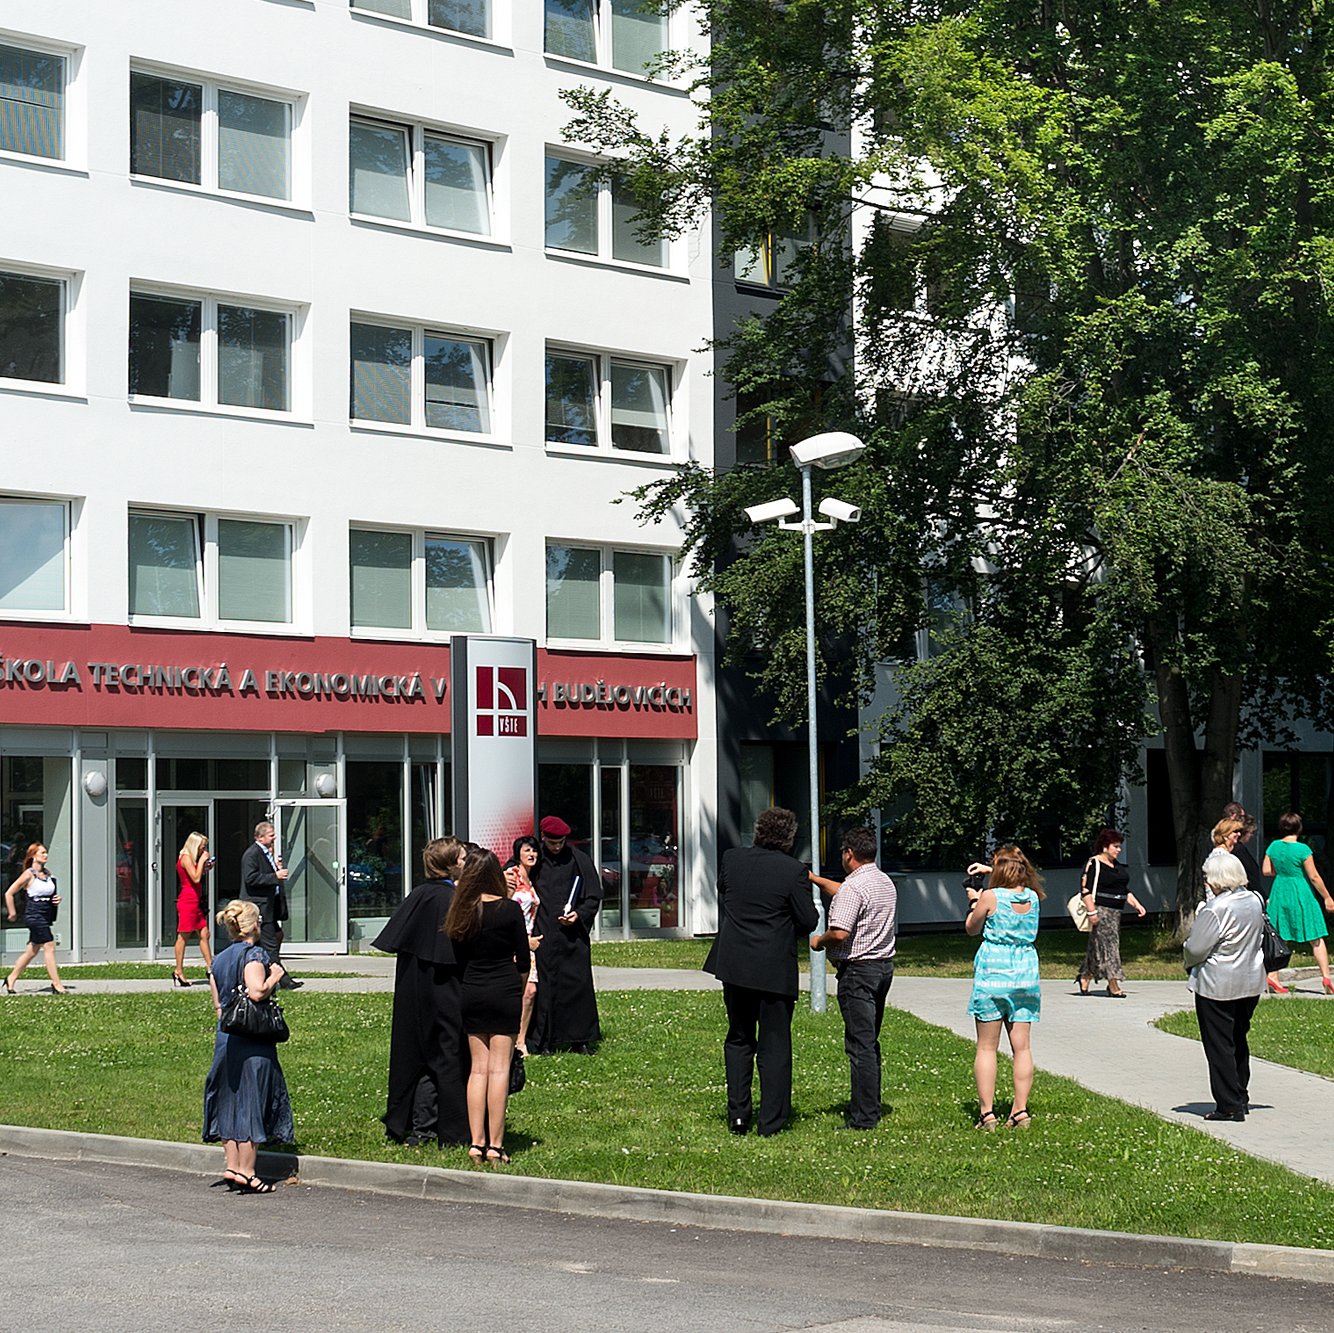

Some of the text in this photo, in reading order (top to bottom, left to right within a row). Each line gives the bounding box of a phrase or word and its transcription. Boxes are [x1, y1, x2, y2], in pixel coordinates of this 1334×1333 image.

[87, 662, 234, 690] TECHNICKÁ
[238, 668, 259, 691] A
[264, 670, 426, 698] EKONOMICKÁ
[431, 677, 446, 698] V
[552, 679, 692, 707] BUDĚJOVICÍCH
[499, 716, 518, 733] VŠTE
